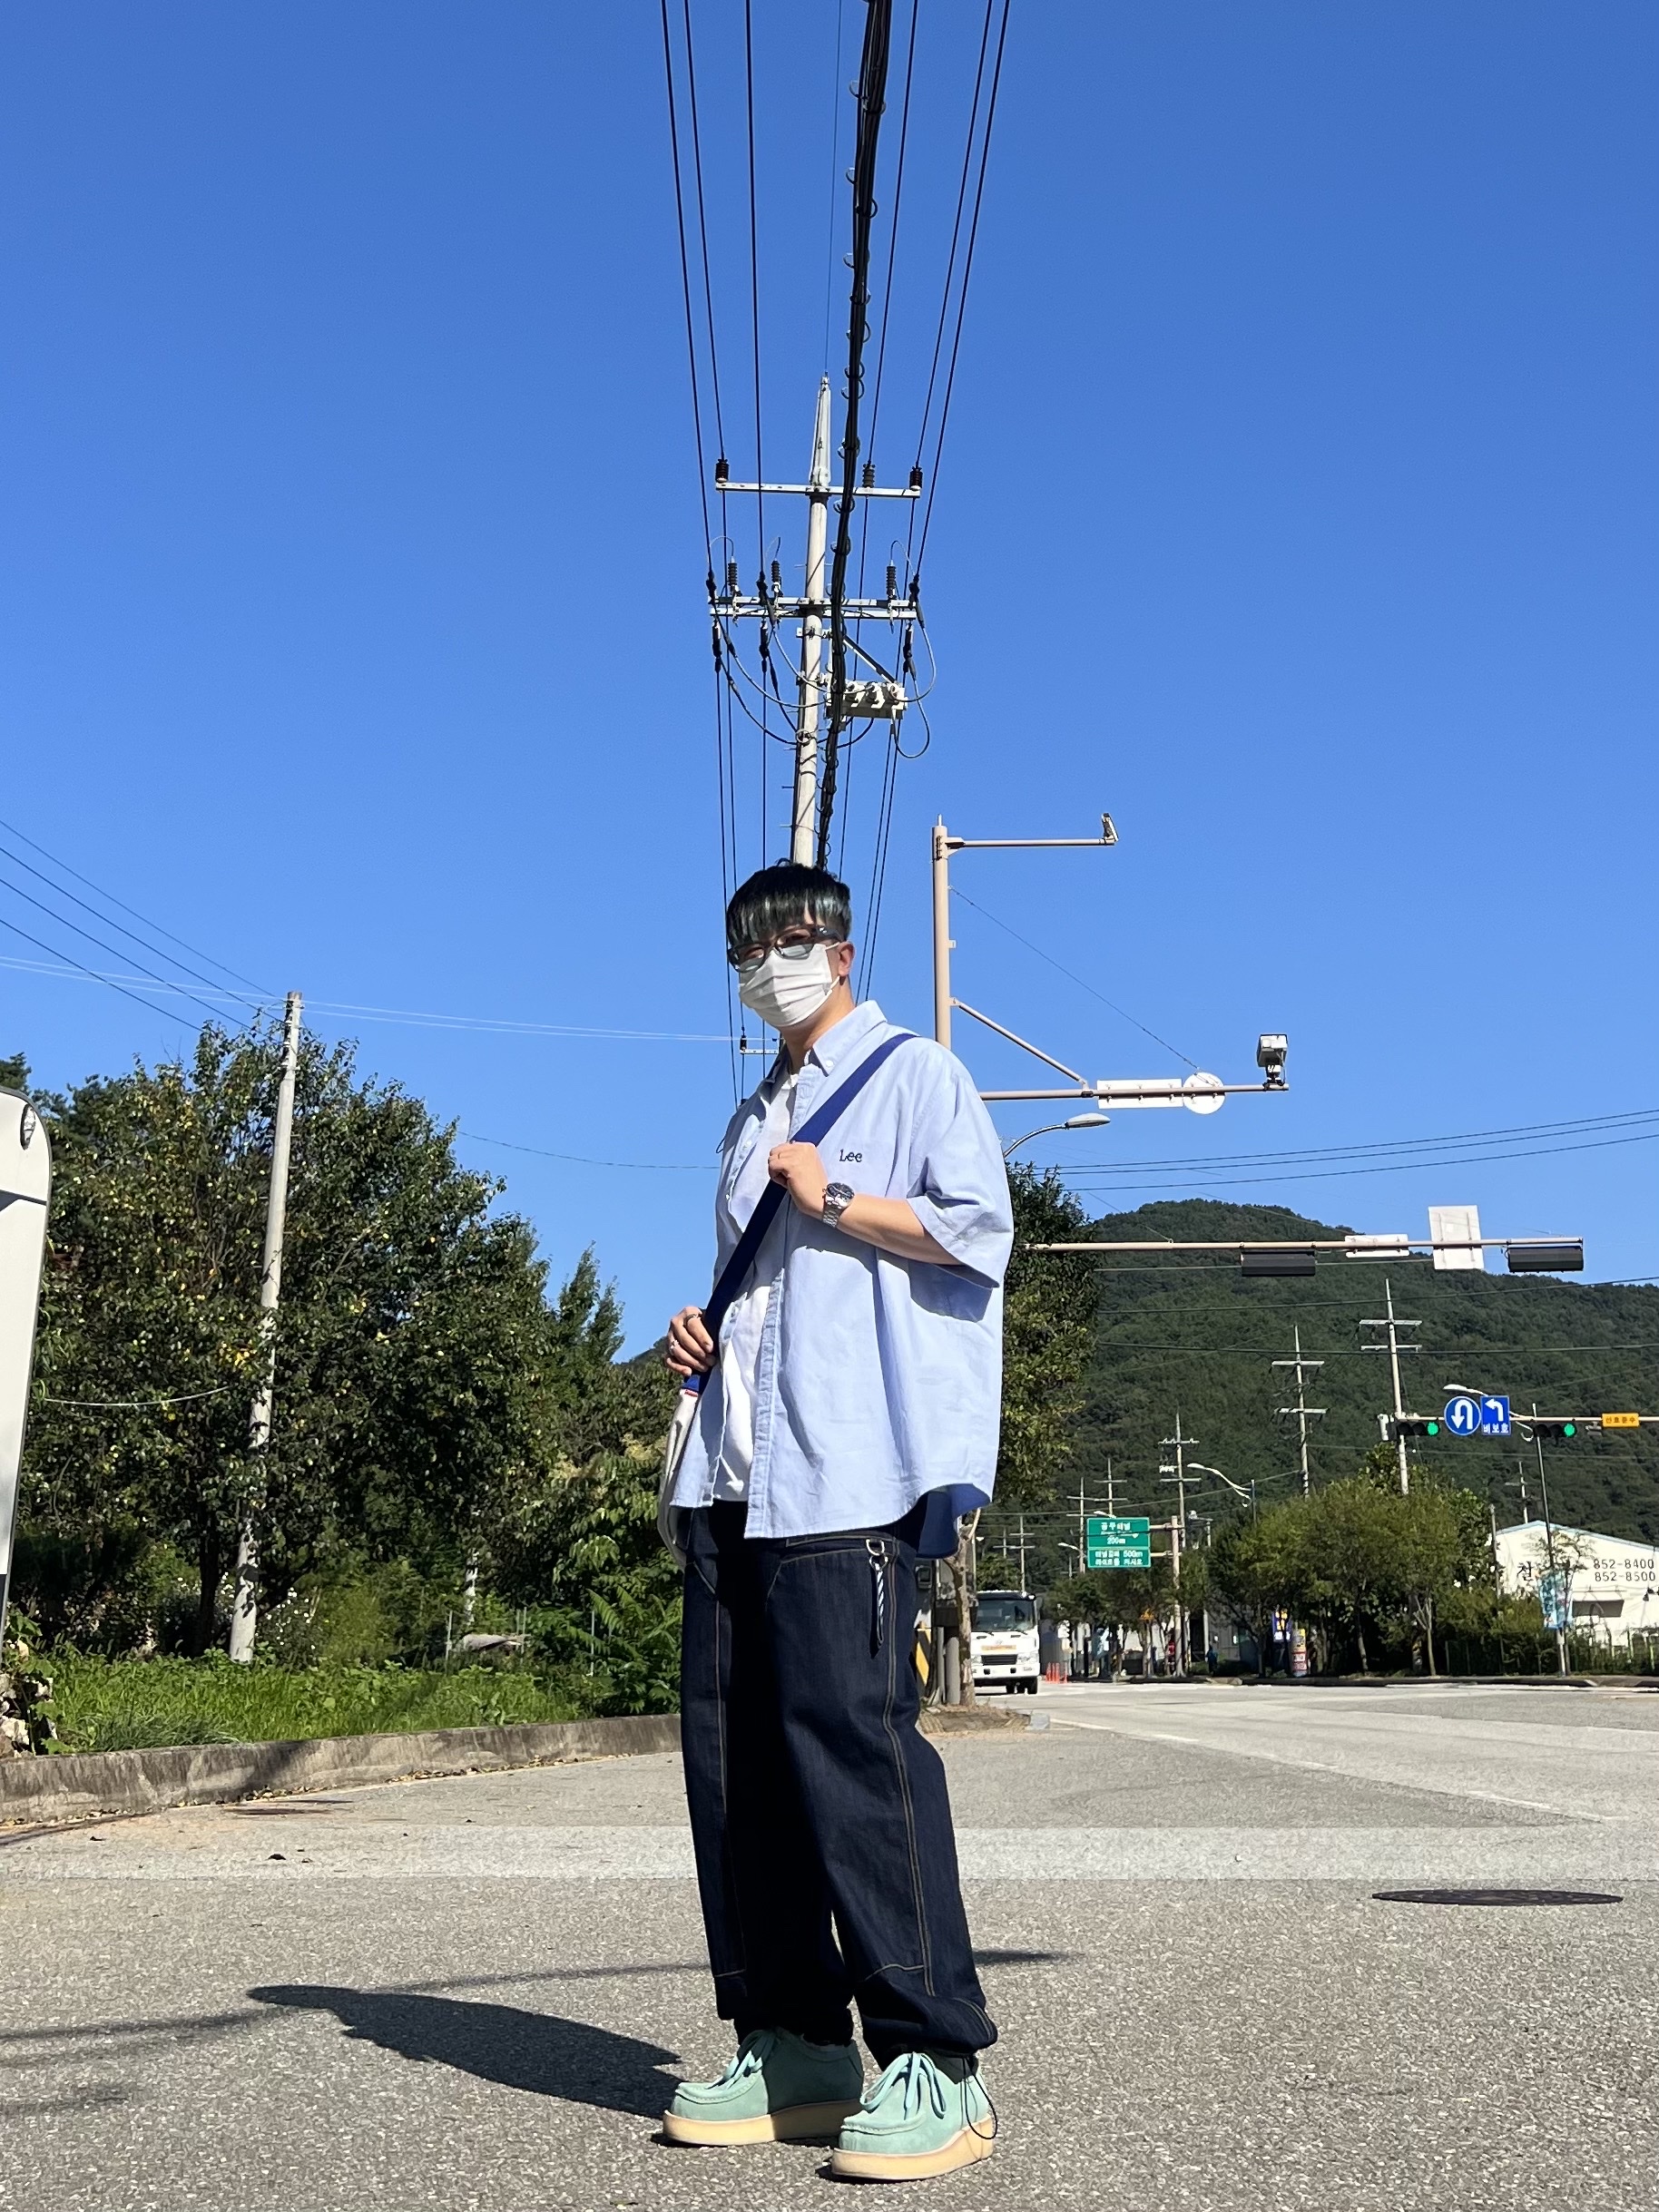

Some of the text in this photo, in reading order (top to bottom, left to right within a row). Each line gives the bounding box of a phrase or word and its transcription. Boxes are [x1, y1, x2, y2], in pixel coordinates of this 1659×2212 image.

[839, 1148, 863, 1163] Lee
[1483, 1422, 1509, 1434] 비보호
[1593, 1558, 1654, 1570] 852-8400
[1595, 1571, 1656, 1582] 852-8500
